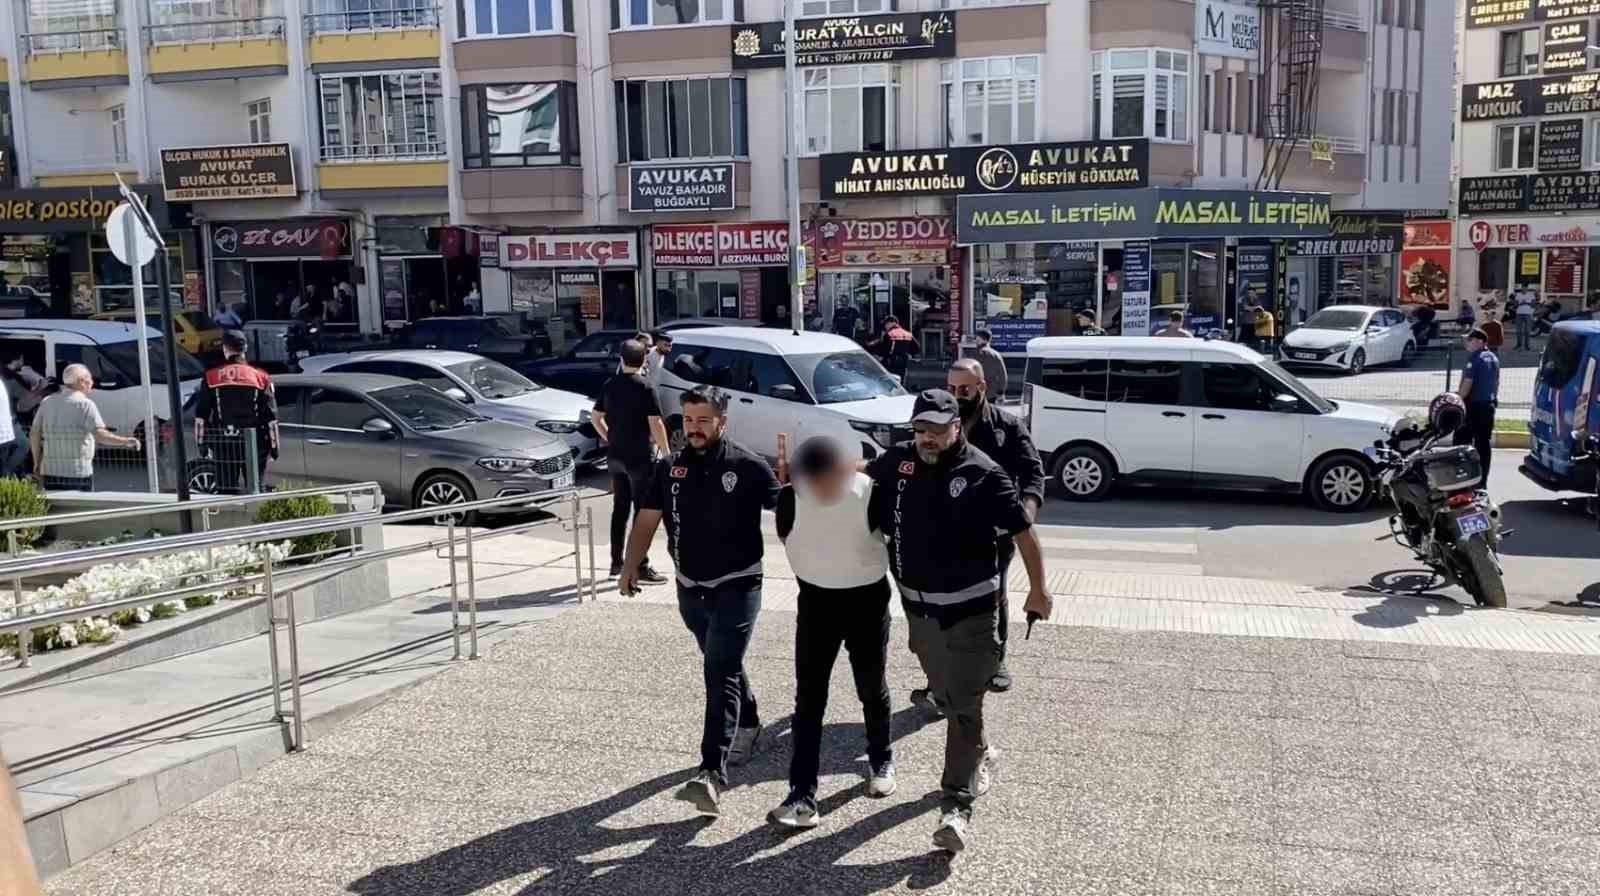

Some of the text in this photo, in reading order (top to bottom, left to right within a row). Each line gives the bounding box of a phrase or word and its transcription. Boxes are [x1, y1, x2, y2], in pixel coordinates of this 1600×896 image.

[823, 17, 860, 27] AVUKAT
[1551, 24, 1580, 39] ÇAM
[831, 41, 840, 49] &
[1478, 83, 1515, 99] MAZ
[1541, 81, 1595, 96] ZEYNEP
[1466, 100, 1522, 118] HUKUK
[1544, 99, 1590, 114] ENVER
[851, 154, 948, 174] AVUKAT
[1029, 145, 1134, 166] AVUKAT
[200, 160, 254, 172] AVUKAT
[179, 171, 277, 187] BURAK ÖLÇER
[638, 167, 726, 185] AVUKAT
[835, 172, 965, 194] NİHAT AHISKALIOĞLU
[1020, 167, 1140, 186] HÜSEYİN GÖKKAYA
[1469, 178, 1517, 189] AVUKAT
[638, 184, 726, 196] YAVUZ BAHADIR
[654, 194, 710, 207] BUĞDAYLI
[40, 199, 118, 221] pastan
[971, 202, 1136, 227] MASAL İLETİŞİM
[1155, 195, 1331, 231] MASAL İLETİŞİM
[842, 218, 949, 240] YEDE DOY
[1473, 223, 1530, 242] bi YER
[655, 231, 713, 254] DİLEKÇE
[719, 229, 788, 252] DİLEKÇ
[1296, 239, 1338, 255] ERKEK
[1340, 235, 1394, 253] KUAFÖRÜ
[507, 236, 630, 268] DİLEKÇE
[722, 254, 762, 265] ARZUHAL
[763, 252, 789, 265] BURO
[218, 367, 256, 381] POL
